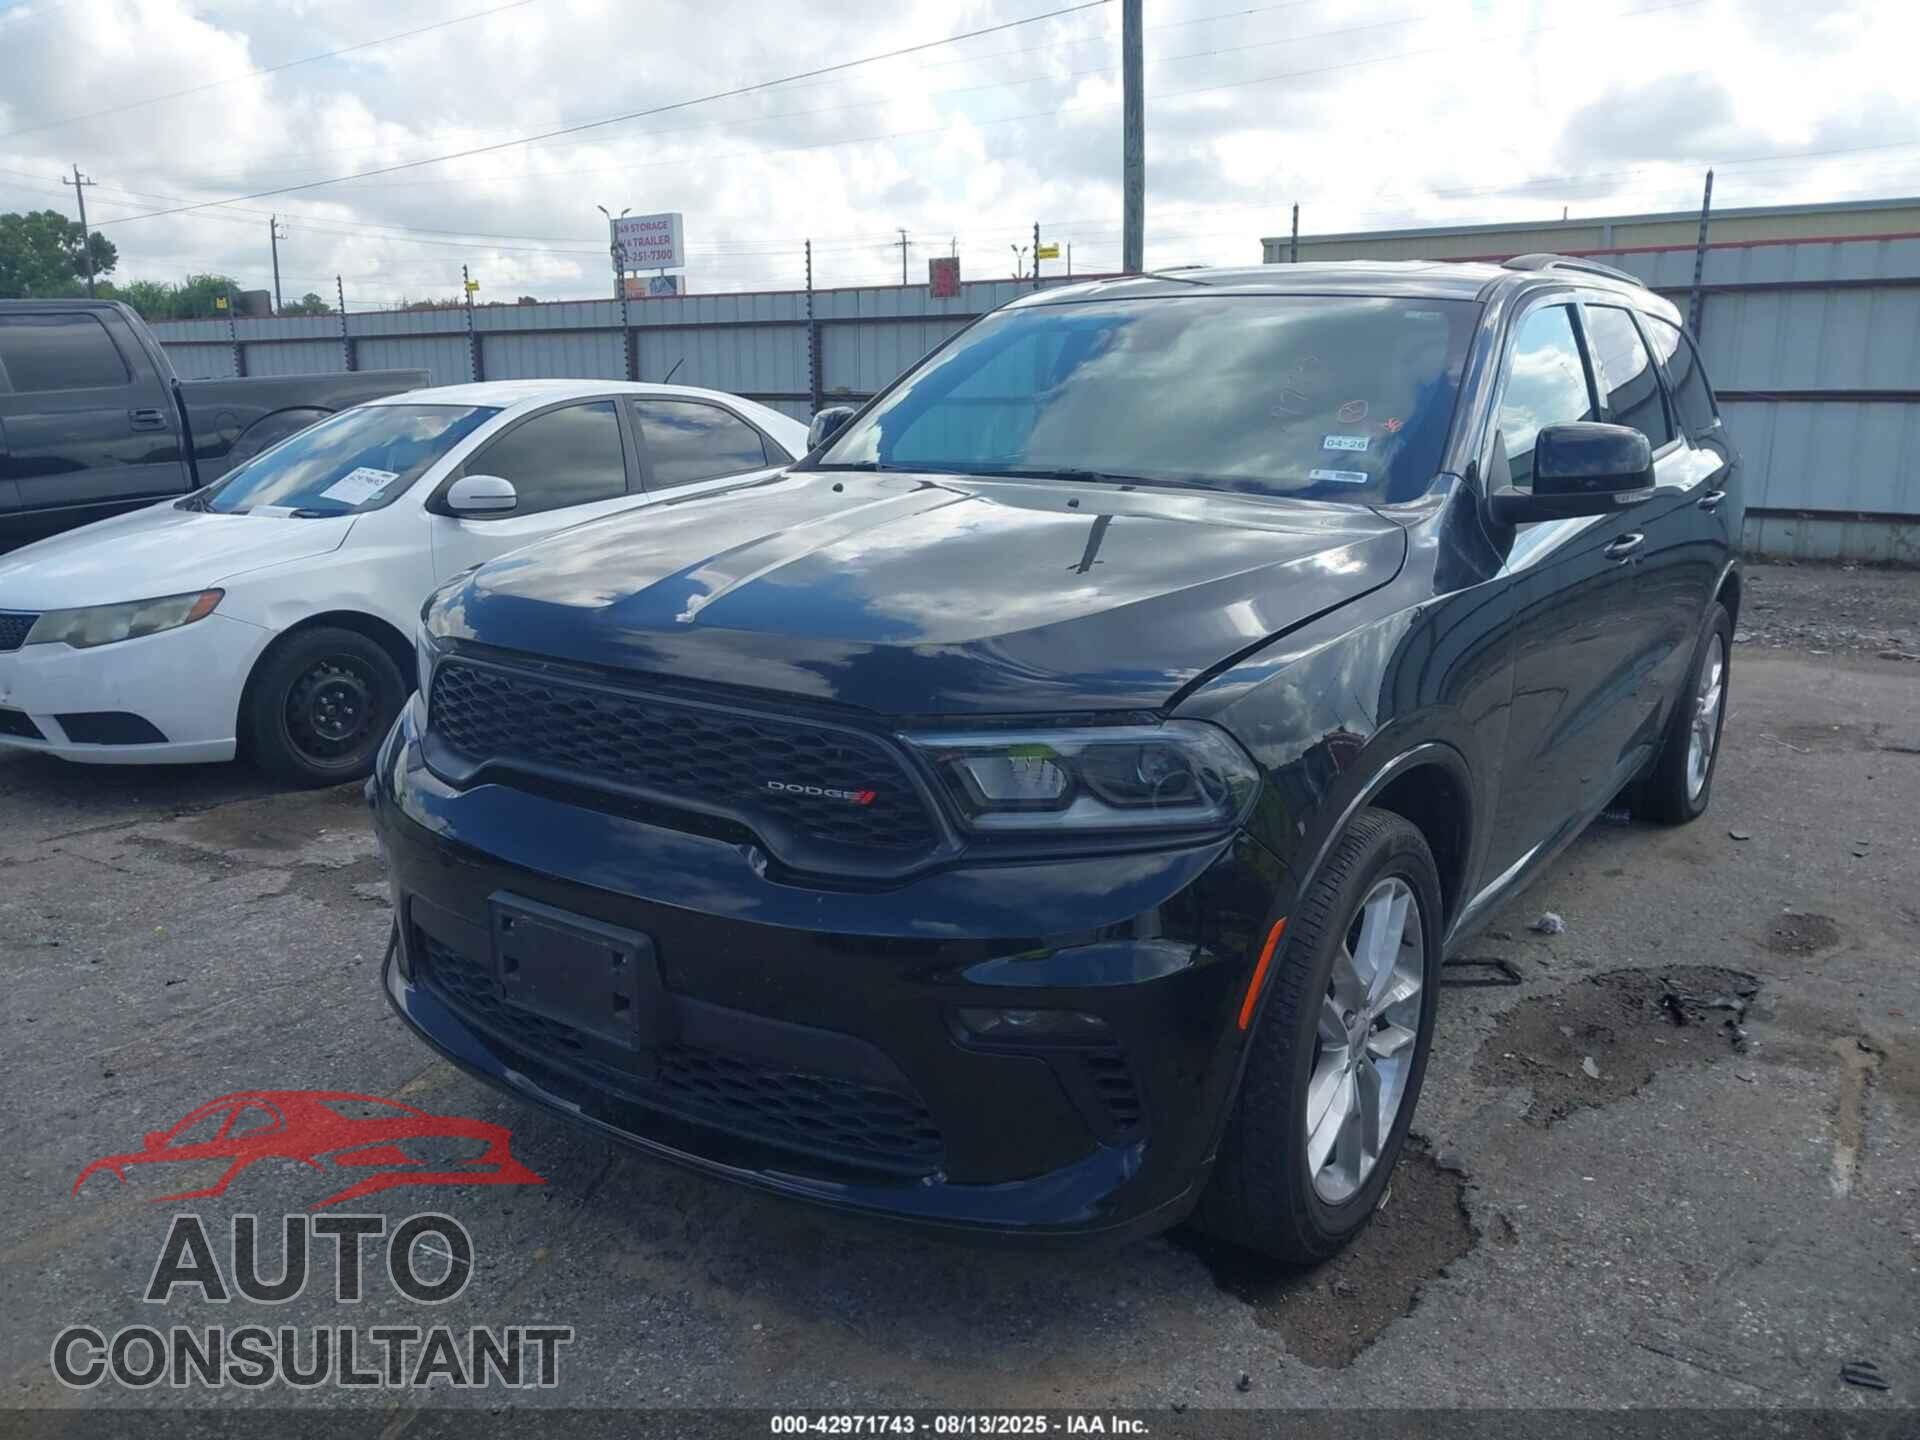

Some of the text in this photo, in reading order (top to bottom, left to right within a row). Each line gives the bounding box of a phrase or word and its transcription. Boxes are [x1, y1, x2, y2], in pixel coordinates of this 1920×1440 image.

[630, 221, 668, 233] STORAGE
[633, 235, 671, 247] TRAILER
[1326, 439, 1367, 450] 04-26
[767, 781, 862, 801] DODGE
